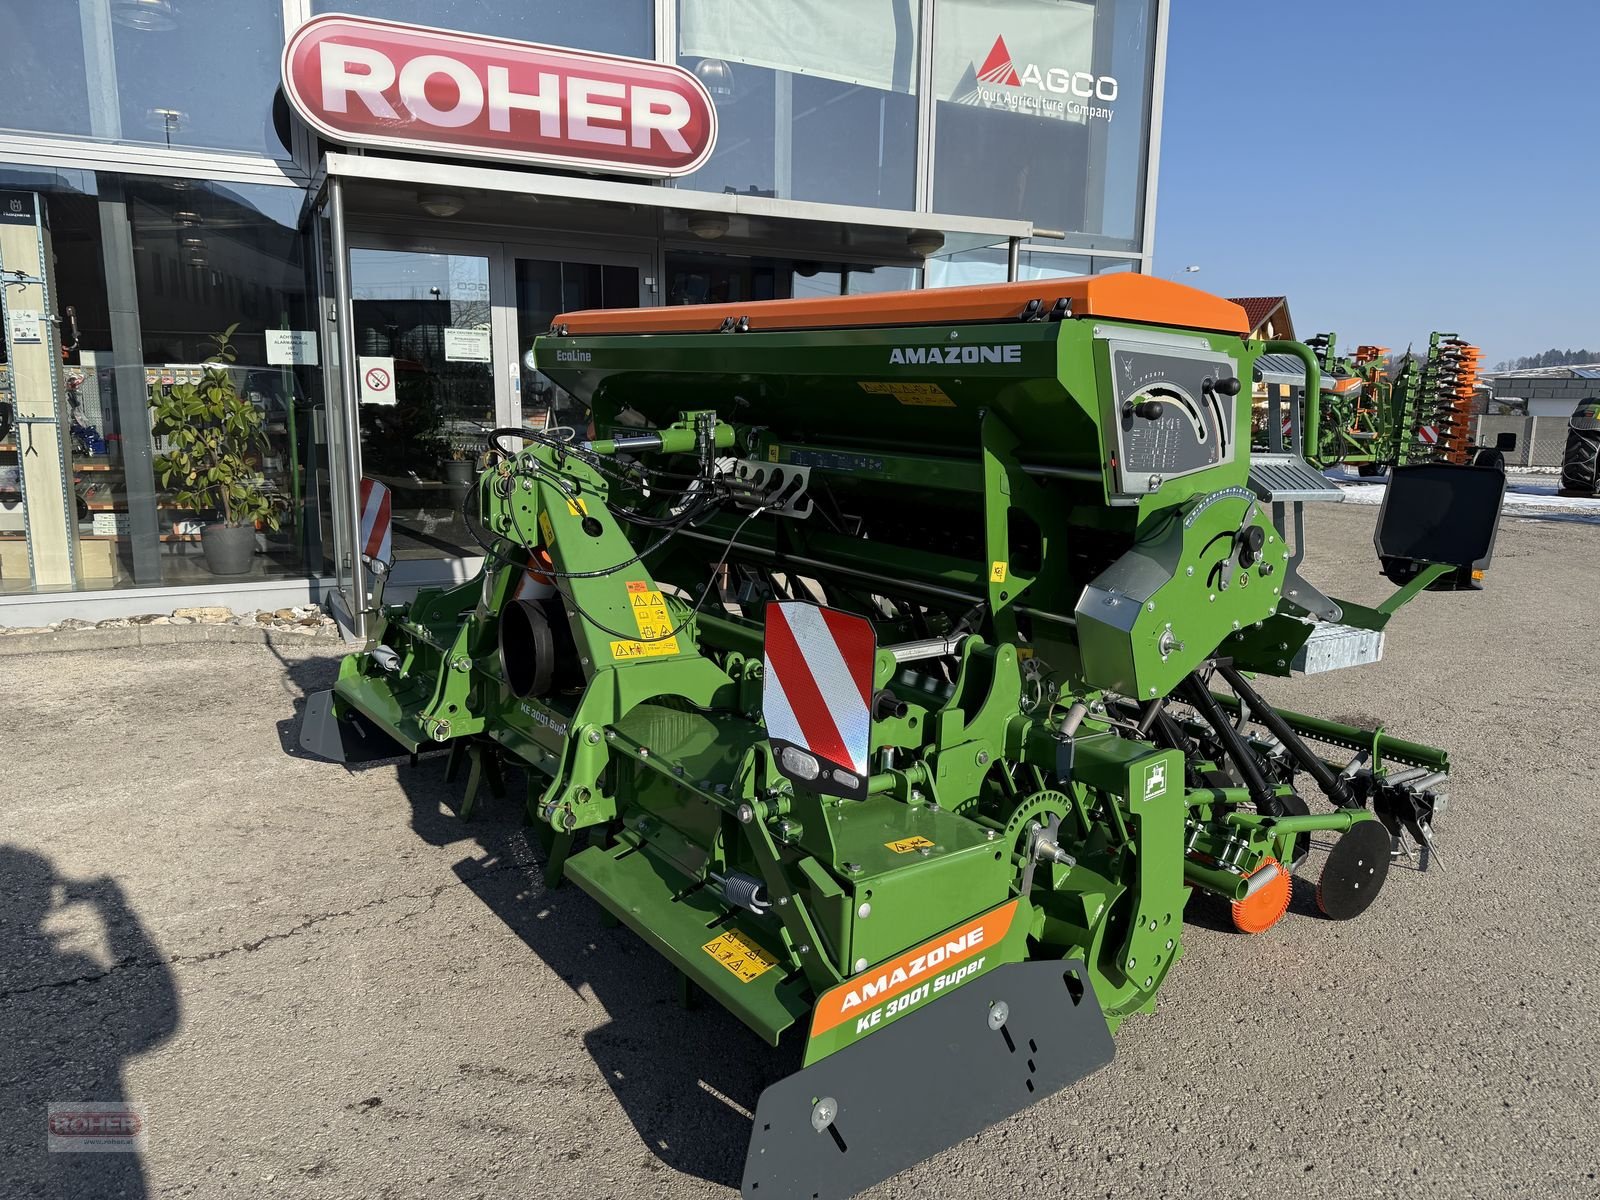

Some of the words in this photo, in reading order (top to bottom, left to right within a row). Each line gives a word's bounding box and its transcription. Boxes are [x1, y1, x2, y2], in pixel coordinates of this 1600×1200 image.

[319, 41, 694, 154] ROHER
[1020, 63, 1118, 101] AGCO
[977, 87, 1000, 102] Your
[1003, 91, 1063, 112] Agriculture
[1067, 101, 1114, 123] Company
[556, 349, 592, 362] EcoLine
[889, 345, 1021, 364] AMAZONE
[521, 702, 531, 715] KE
[530, 709, 549, 725] 3001
[550, 719, 568, 736] Sup
[841, 926, 984, 1013] AMAZONE
[856, 1008, 882, 1034] KE
[886, 982, 930, 1018] 3001
[933, 956, 986, 993] Super
